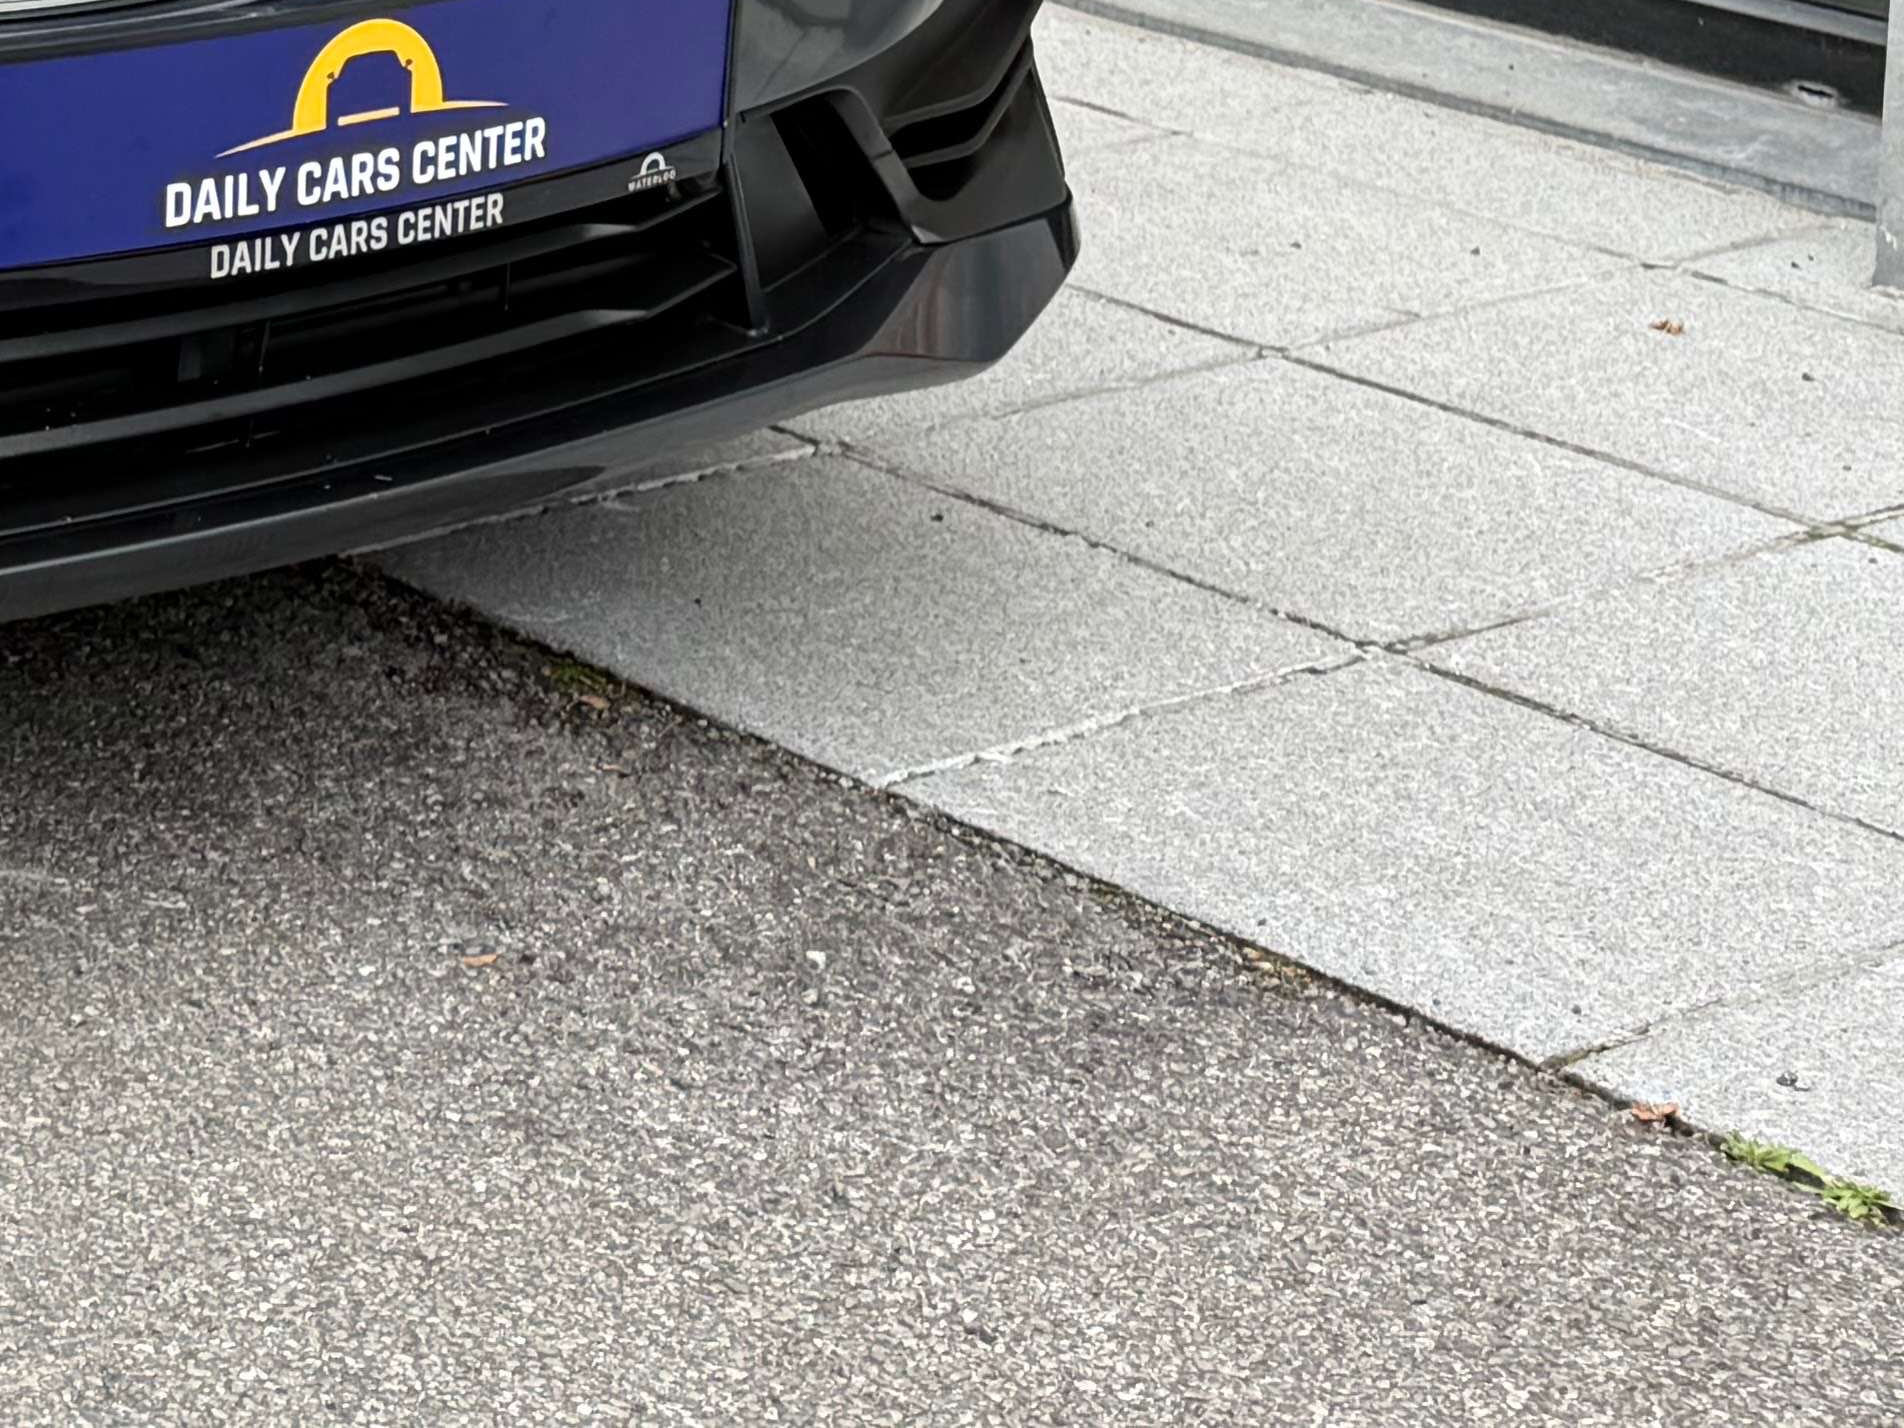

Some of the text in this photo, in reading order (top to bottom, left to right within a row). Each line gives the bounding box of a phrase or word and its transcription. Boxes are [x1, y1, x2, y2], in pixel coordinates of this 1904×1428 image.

[164, 116, 546, 228] DAILY CARS CENTER
[210, 193, 504, 279] DAILY CARS CENTER
